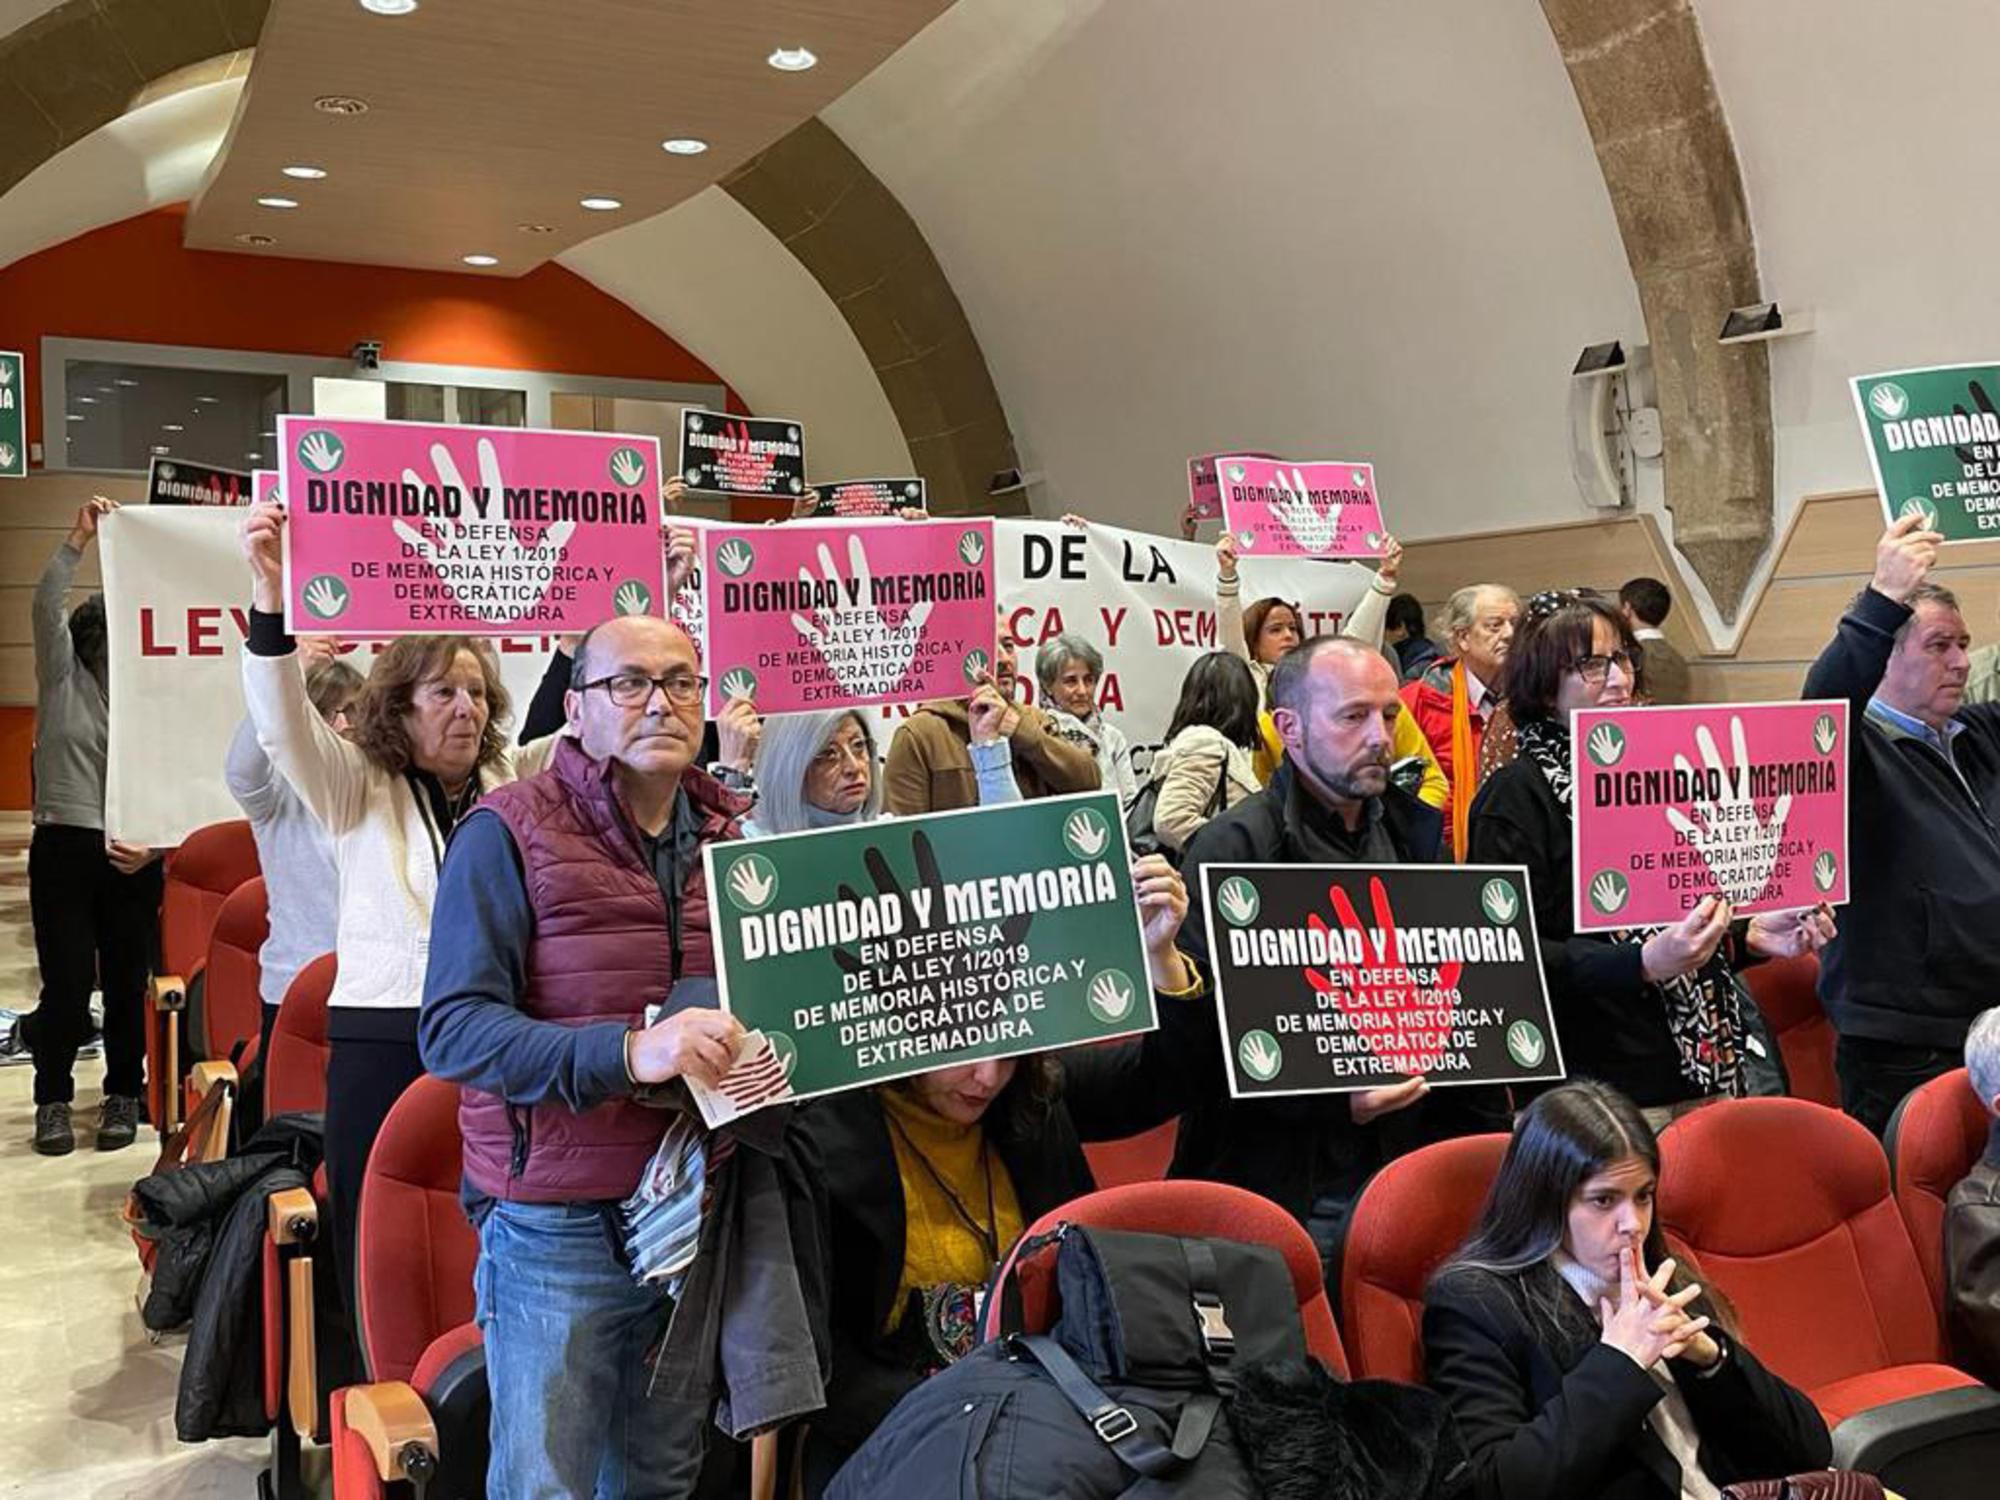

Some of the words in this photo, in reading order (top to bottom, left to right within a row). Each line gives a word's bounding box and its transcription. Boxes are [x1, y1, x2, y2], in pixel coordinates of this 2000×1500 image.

[1883, 412, 2000, 452] DIGNIDAD
[1972, 445, 1994, 460] EN
[1963, 463, 1985, 478] DE
[308, 479, 462, 519] DIGNIDAD
[474, 487, 491, 520] Y
[503, 487, 647, 524] MEMORIA
[1232, 486, 1292, 504] DIGNIDAD
[1308, 489, 1372, 505] MEMORIA
[1931, 483, 1954, 498] DE
[421, 524, 447, 539] EN
[455, 525, 549, 541] DEFENSA
[402, 543, 428, 558] DE
[436, 544, 461, 560] LA
[467, 545, 505, 561] LEY
[514, 547, 568, 562] 1/2019
[1023, 535, 1087, 580] DE
[1123, 540, 1177, 583] LA
[351, 562, 379, 578] DE
[387, 563, 484, 580] MEMORIA
[491, 563, 599, 582] HISTÓRICA
[603, 567, 614, 582] Y
[394, 582, 546, 600] DEMOCRÁTICA
[552, 587, 577, 601] DE
[724, 577, 839, 614] DIGNIDAD
[848, 577, 862, 607] Y
[871, 570, 986, 606] MEMORIA
[409, 604, 564, 620] EXTREMADURA
[812, 613, 832, 627] EN
[834, 609, 912, 627] DEFENSA
[798, 632, 817, 648] DE
[823, 630, 847, 645] LA
[847, 628, 875, 644] LEY
[880, 625, 929, 642] 1/2019
[1099, 607, 1127, 647] Y
[759, 652, 781, 667] DE
[786, 647, 857, 666] MEMORIA
[862, 641, 953, 661] HISTÓRICA
[954, 639, 965, 654] Y
[792, 663, 908, 685] DEMOCRÁTICA
[913, 660, 935, 675] DE
[803, 679, 926, 702] EXTREMADURA
[1594, 767, 1722, 808] DIGNIDAD
[1728, 766, 1742, 800] Y
[1750, 760, 1837, 799] MEMORIA
[1690, 808, 1712, 824] EN
[1716, 802, 1776, 823] DEFENSA
[1674, 831, 1697, 847] DE
[1702, 829, 1722, 845] LA
[1725, 825, 1750, 843] LEY
[1630, 853, 1655, 871] DE
[1661, 848, 1738, 869] MEMORIA
[1806, 839, 1815, 853] Y
[1668, 866, 1773, 891] DEMOCRÁTICA
[1775, 861, 1793, 879] DE
[740, 892, 903, 962] DIGNIDAD
[910, 888, 933, 930] Y
[943, 862, 1118, 926] MEMORIA
[860, 944, 890, 966] EN
[896, 925, 1005, 960] DEFENSA
[1229, 928, 1363, 967] DIGNIDAD
[1371, 928, 1390, 964] Y
[1396, 927, 1526, 964] MEMORIA
[843, 973, 875, 994] DE
[878, 966, 908, 989] LA
[913, 957, 956, 984] LEY
[962, 944, 1031, 973] 1/2019
[1329, 970, 1354, 987] EN
[1359, 967, 1443, 986] DEFENSA
[794, 1007, 825, 1030] DE
[831, 988, 935, 1023] MEMORIA
[940, 965, 1068, 1002] HISTÓRICA
[1071, 958, 1087, 979] Y
[1315, 992, 1340, 1009] DE
[1345, 991, 1370, 1008] LA
[1375, 990, 1408, 1007] LEY
[1412, 989, 1462, 1006] 1/2019
[840, 996, 1005, 1046] DEMOCRÁTICA
[1013, 990, 1046, 1013] DE
[1276, 1015, 1302, 1034] DE
[1306, 1012, 1393, 1033] MEMORIA
[1397, 1005, 1492, 1030] HISTÓRICA
[1494, 1008, 1505, 1026] Y
[857, 1018, 1034, 1069] EXTREMADURA
[1317, 1031, 1450, 1054] DEMOCRÁTICA
[1453, 1030, 1477, 1049] DE
[1332, 1053, 1472, 1077] EXTREMADURA
